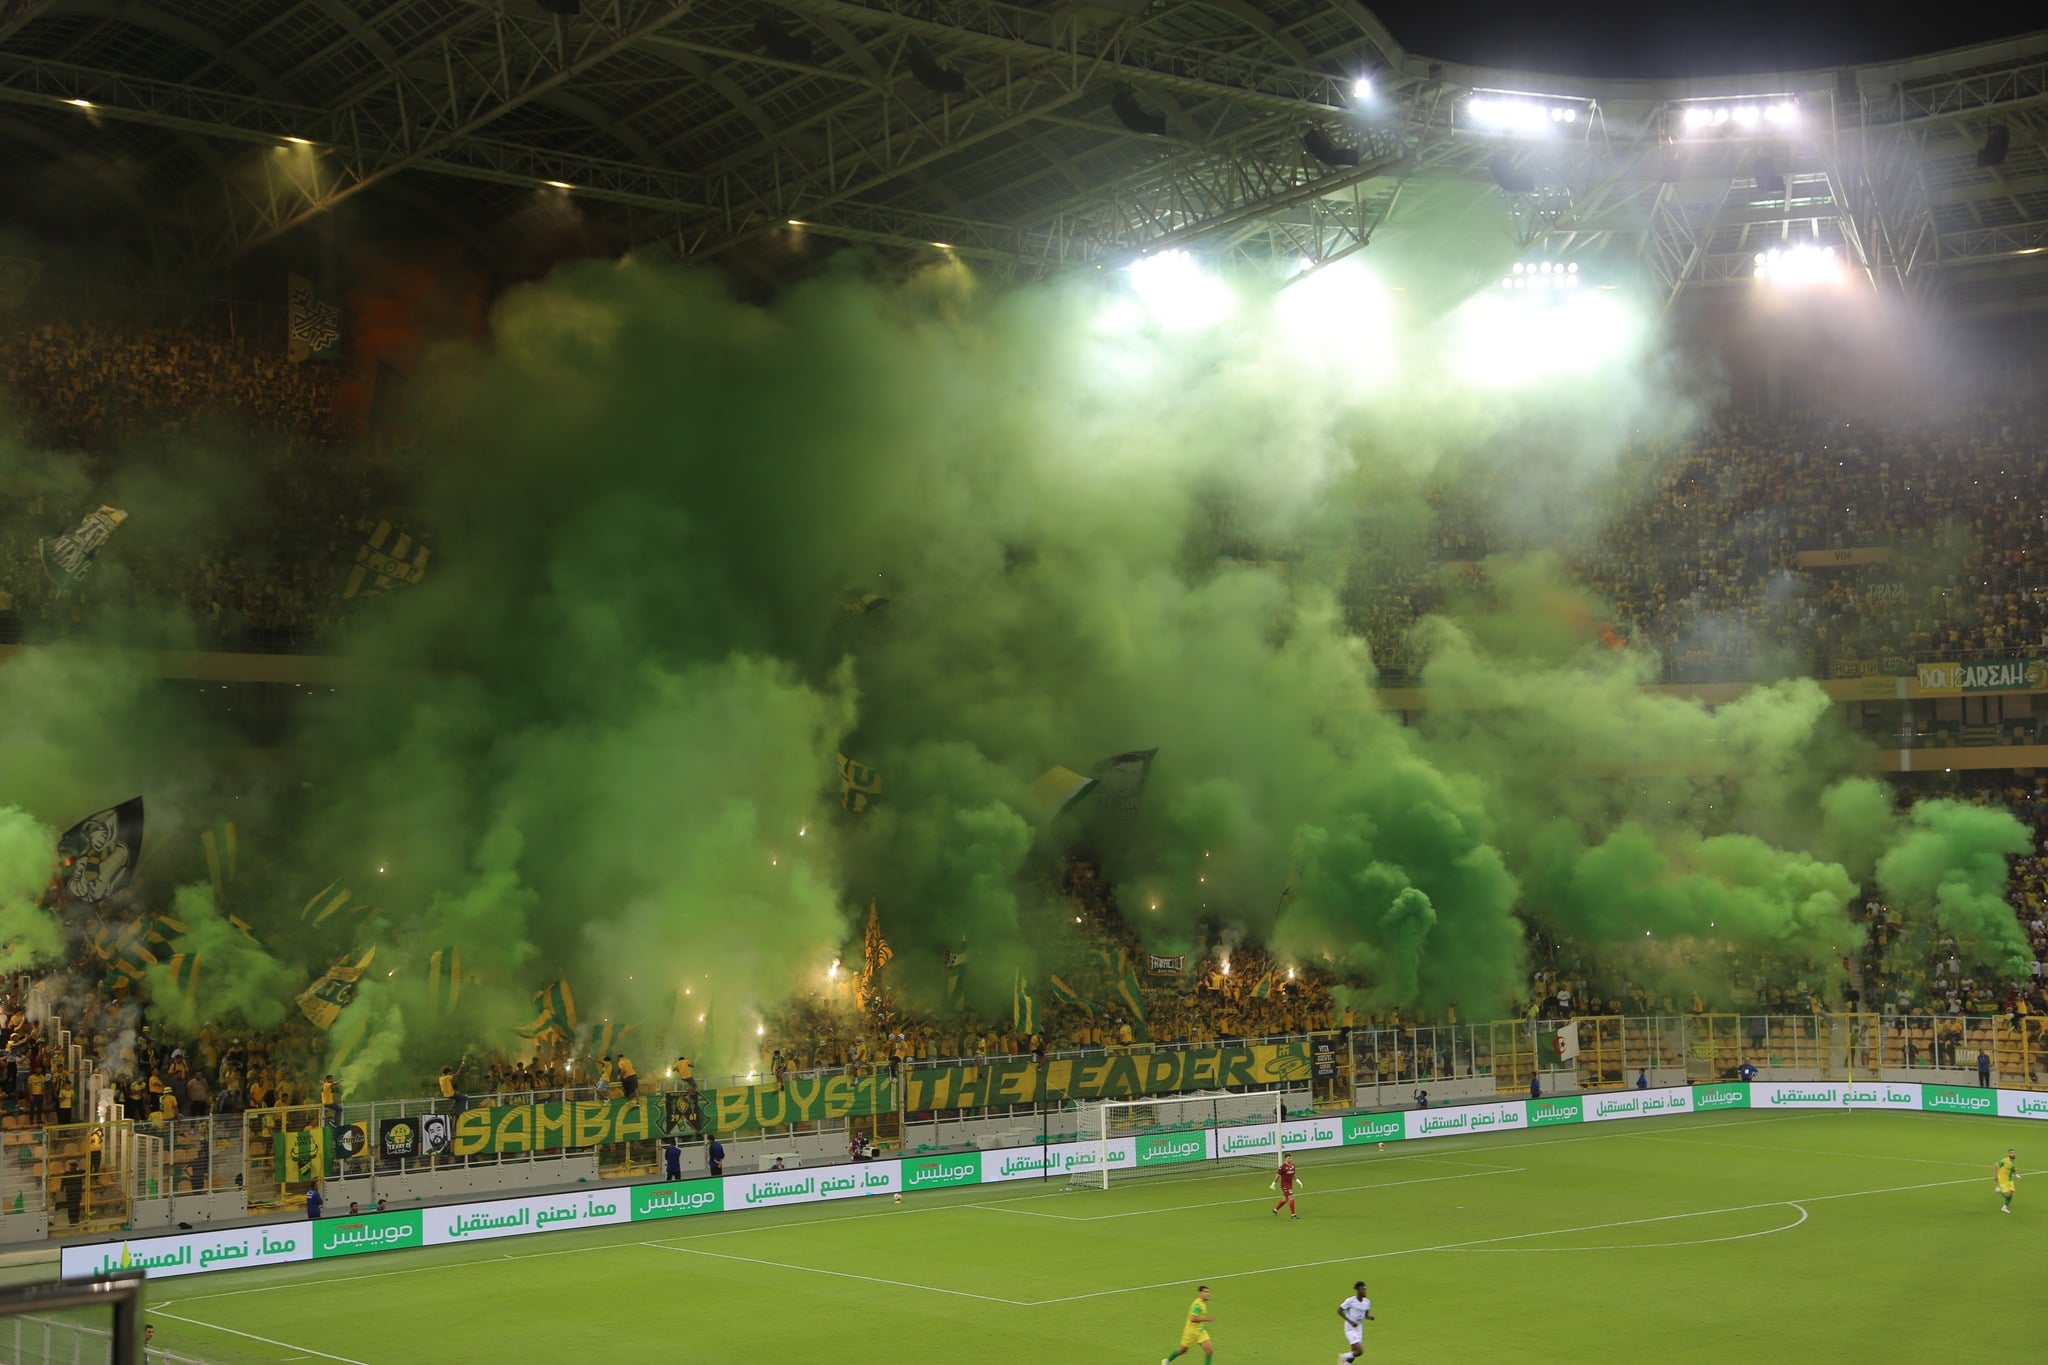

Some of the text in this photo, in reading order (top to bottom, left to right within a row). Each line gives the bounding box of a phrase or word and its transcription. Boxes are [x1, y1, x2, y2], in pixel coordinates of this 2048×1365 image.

[910, 1047, 1258, 1111] THE LEADER
[1596, 1097, 1639, 1118] المستقبل
[1642, 1097, 1665, 1114] نصنع
[1698, 1091, 1743, 1107] موبيليس
[1771, 1089, 1837, 1105] المستقبل
[1842, 1090, 1877, 1105] نصنع
[1928, 1093, 1991, 1110] موبيليس
[1420, 1113, 1467, 1135] المستقبل
[1471, 1112, 1495, 1131] نصنع
[1532, 1105, 1578, 1122] موبيليس
[454, 1096, 649, 1156] SAMBA
[1348, 1122, 1400, 1140] موبيليس
[1142, 1141, 1200, 1161] موبيليس
[1223, 1131, 1276, 1154] المستقبل
[910, 1165, 974, 1185] موبيليس
[1000, 1152, 1060, 1177] المستقبل
[745, 1177, 815, 1204] المستقبل
[820, 1175, 855, 1197] نصنع
[639, 1191, 715, 1214] موبيليس
[448, 1207, 530, 1237] المستقبل
[536, 1204, 577, 1229] نصنع
[323, 1225, 413, 1250] موبيليس
[94, 1245, 192, 1275] المستبل
[199, 1240, 249, 1268] نصنع
